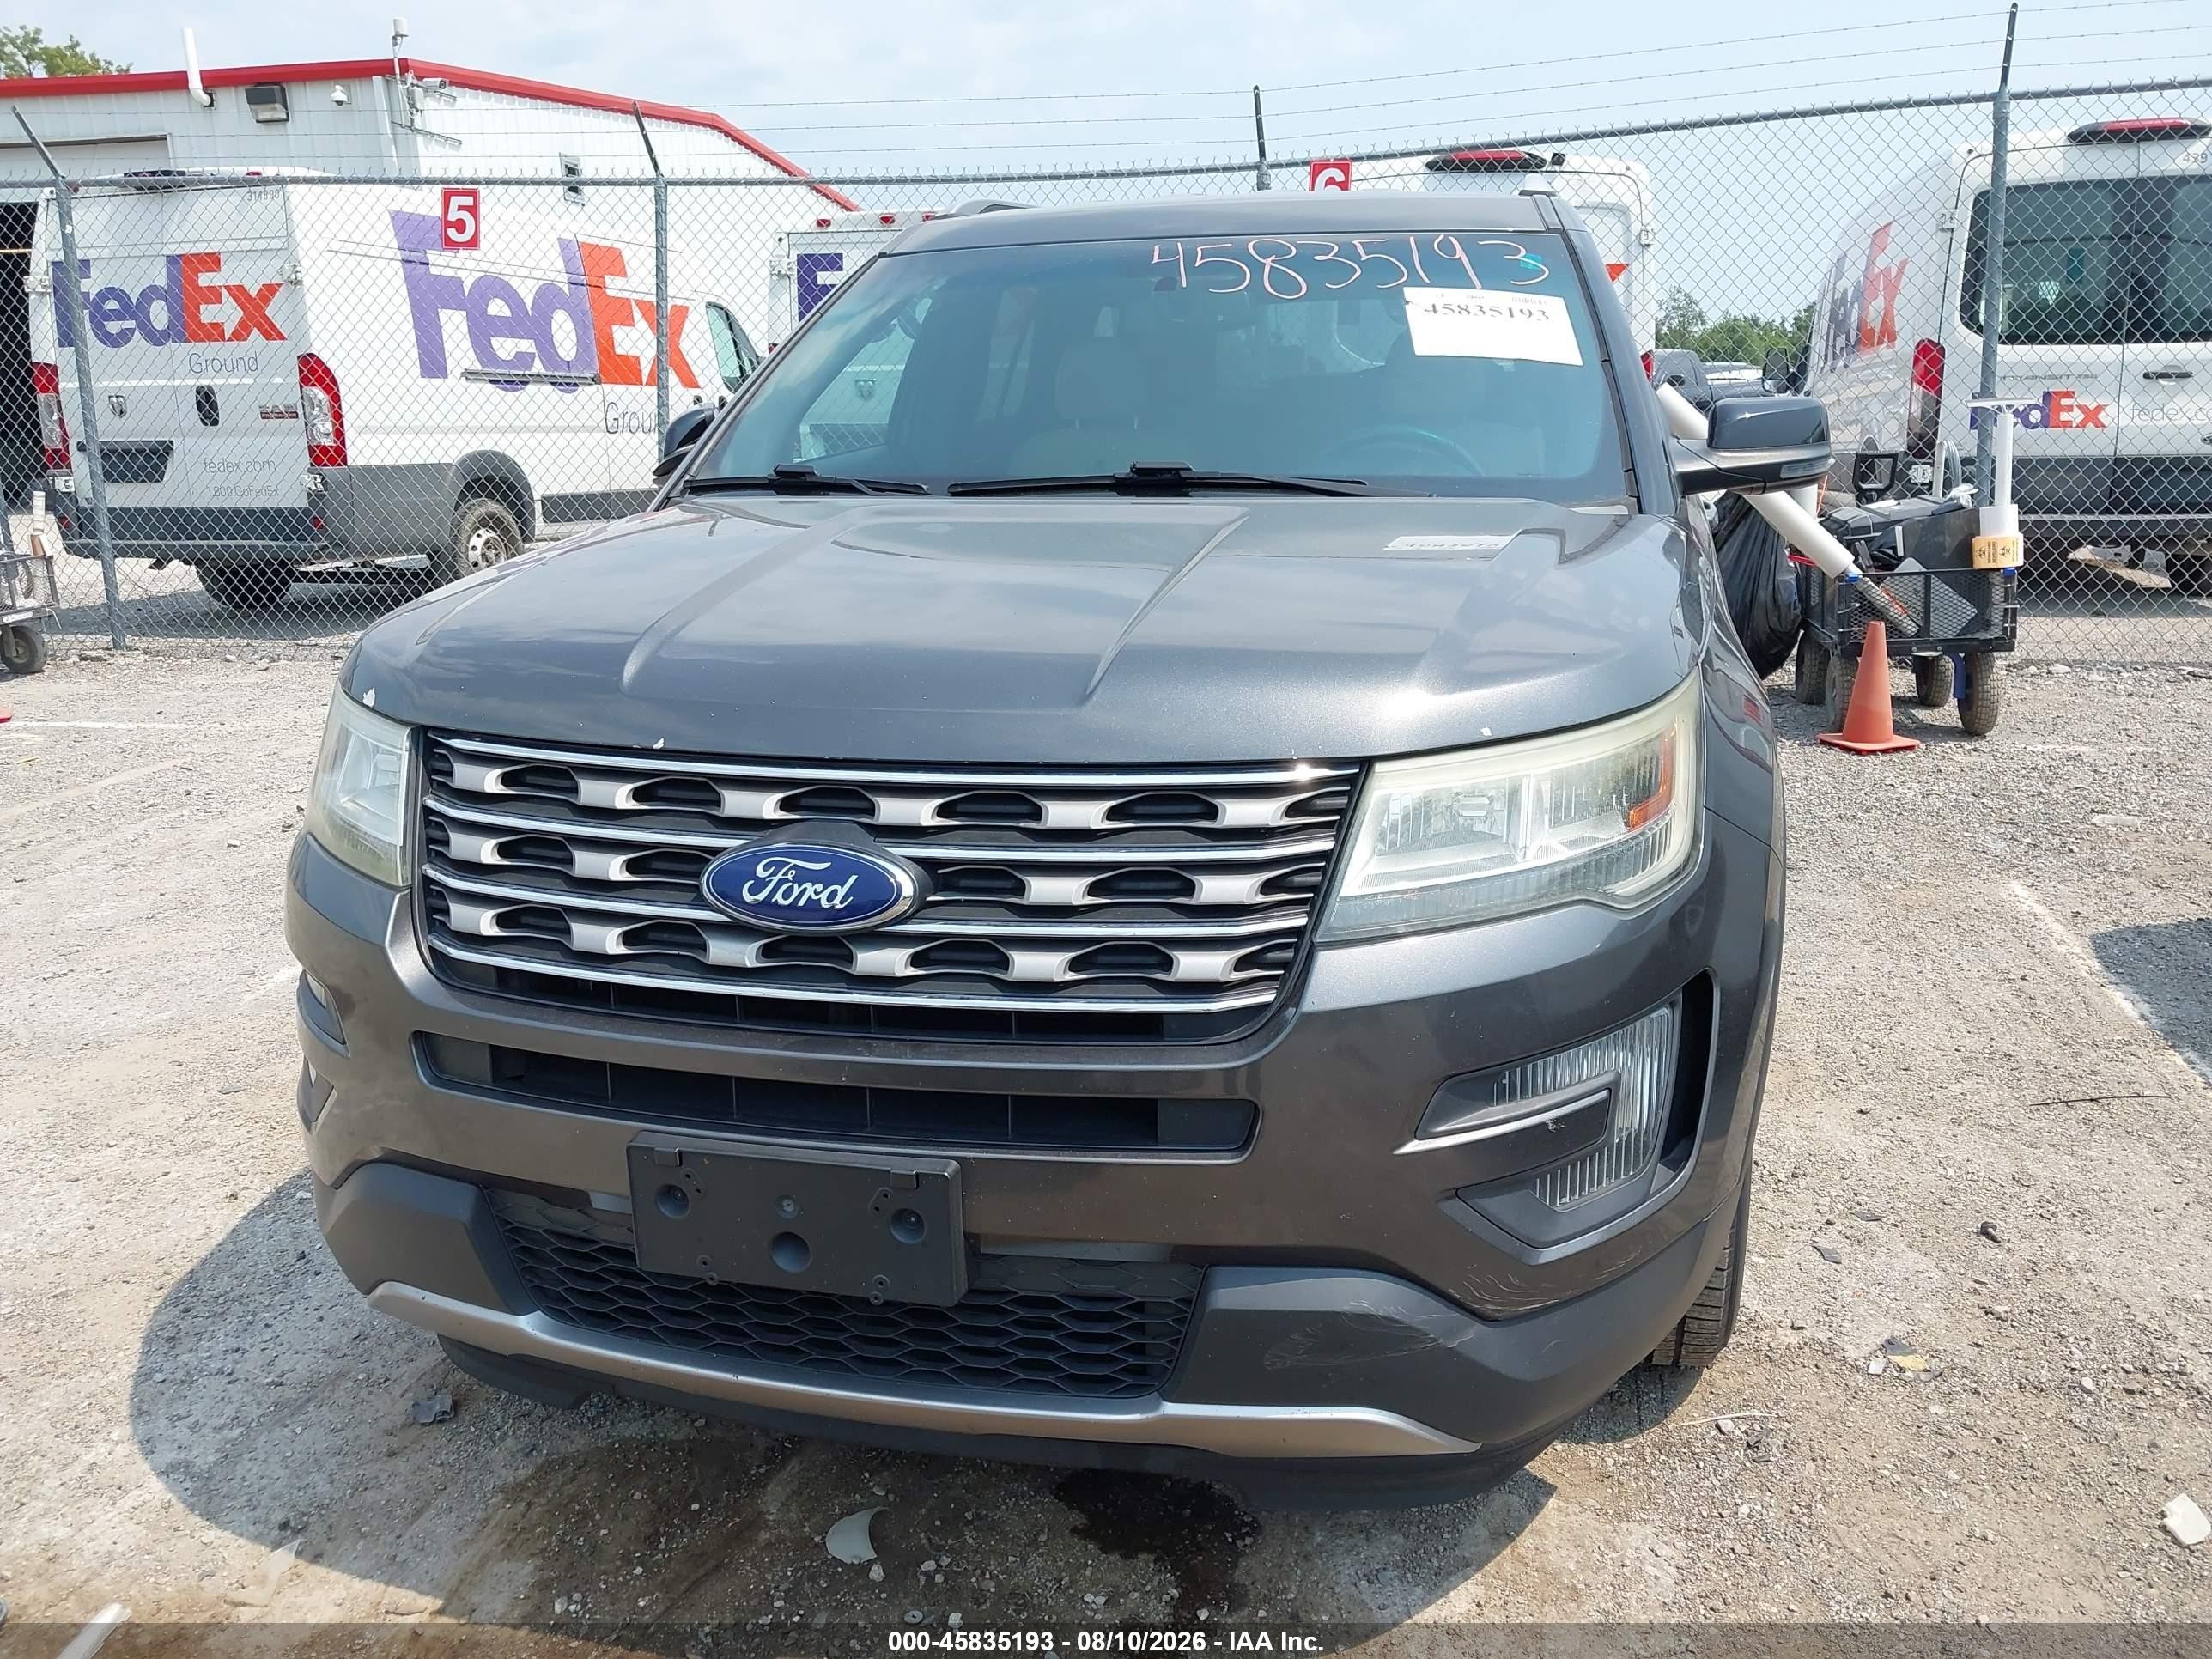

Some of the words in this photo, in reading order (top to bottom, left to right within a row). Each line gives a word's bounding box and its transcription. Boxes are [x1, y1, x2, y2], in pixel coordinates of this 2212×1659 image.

[446, 196, 476, 242] 5
[1151, 234, 1549, 299] 45835193
[52, 252, 288, 348] FedEx
[387, 209, 701, 393] FedEx
[1424, 302, 1550, 322] 45835193
[189, 350, 258, 374] Ground
[1970, 389, 2108, 430] dEx
[742, 856, 859, 910] Ford
